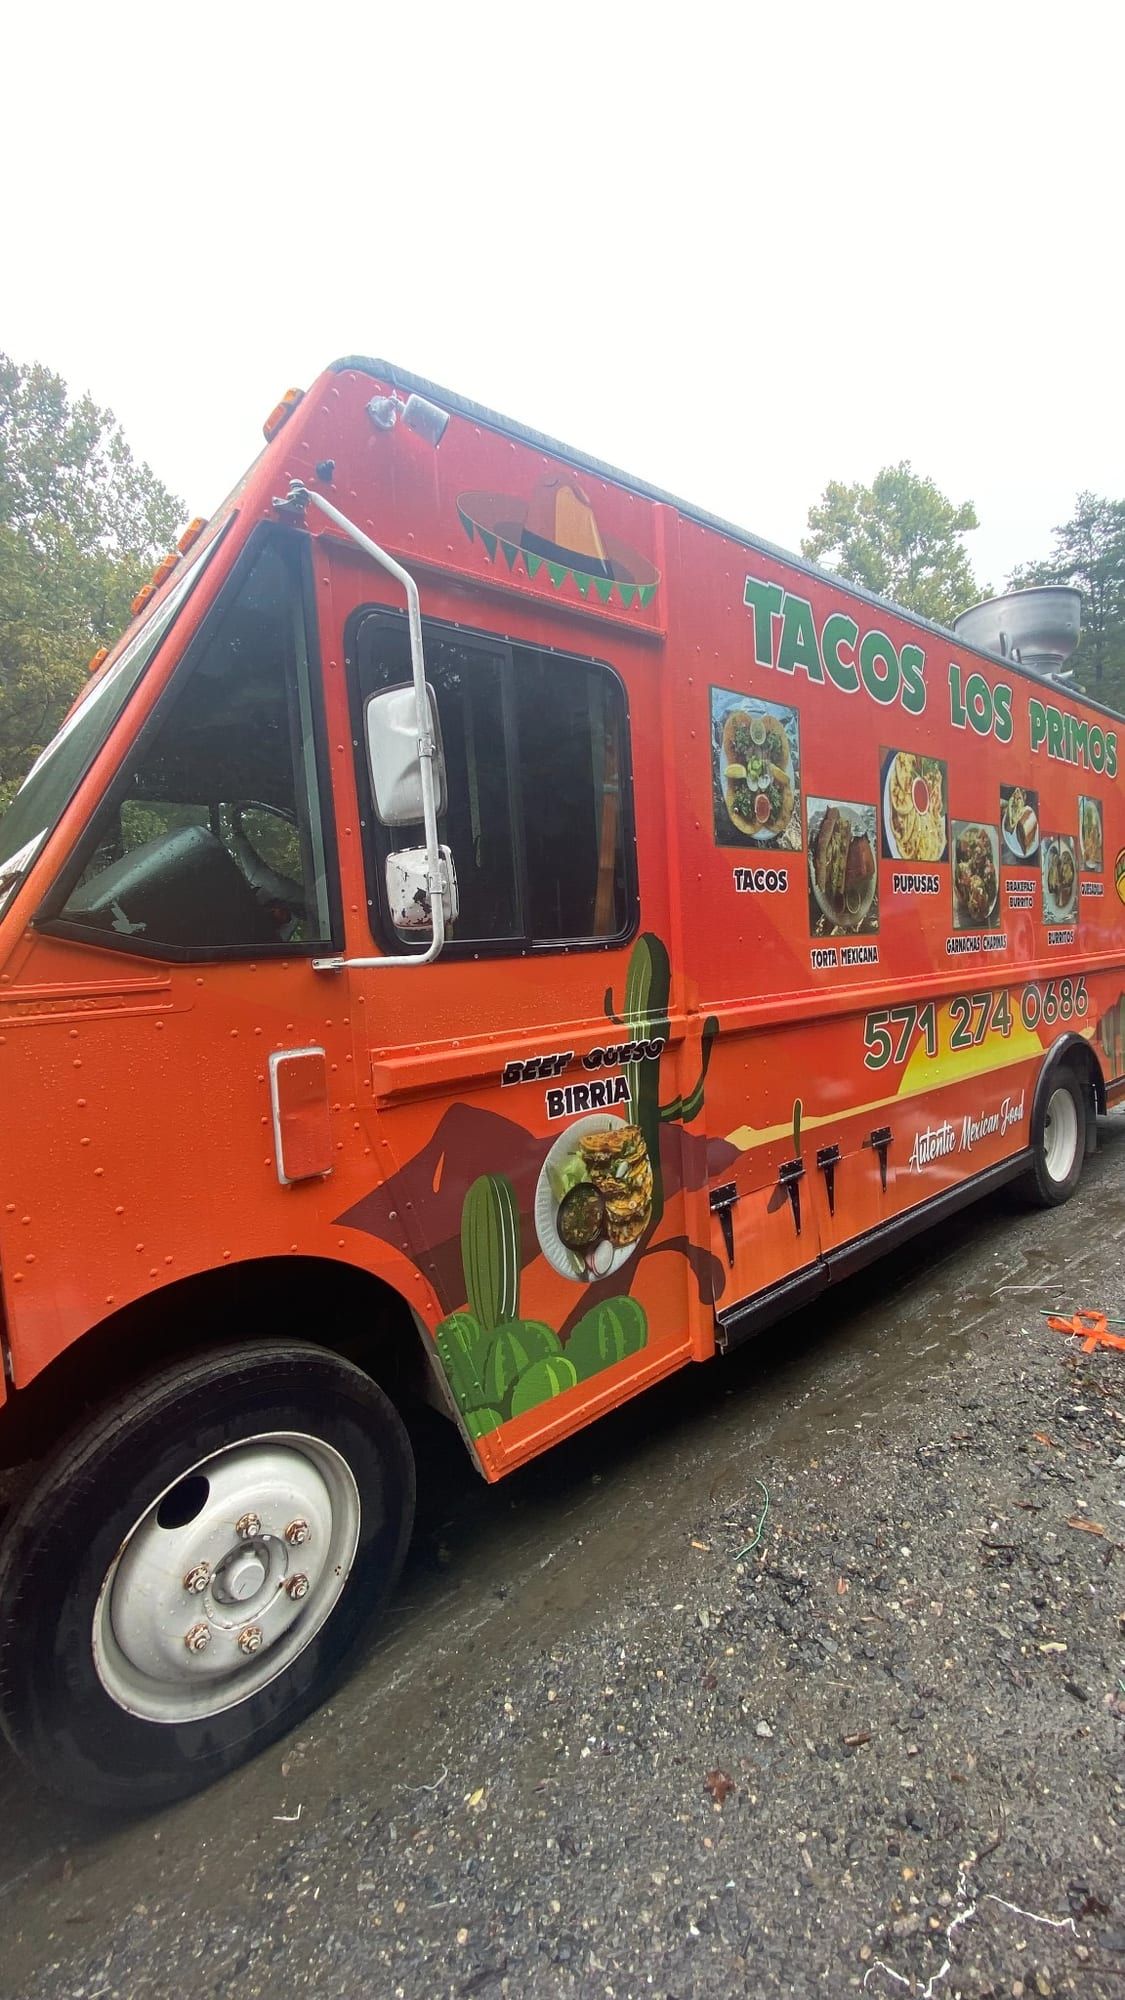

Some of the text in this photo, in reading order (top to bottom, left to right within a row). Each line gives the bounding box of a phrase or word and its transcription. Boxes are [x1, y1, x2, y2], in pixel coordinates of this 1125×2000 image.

[743, 575, 1117, 778] TACOS LOS PRIMOS
[734, 868, 788, 892] TACOS
[893, 873, 940, 894] PUPUSAS
[1009, 896, 1033, 908] BURRITO
[946, 936, 981, 955] GARNACHAS
[1048, 930, 1074, 945] BURRITOS
[811, 946, 879, 969] TORTA MEXICANA
[864, 976, 1088, 1070] 571 274 0686
[501, 1037, 666, 1087] BEEF QUESO
[546, 1075, 632, 1120] BIRRIA
[908, 1089, 1025, 1173] Autentic Mexican Food
